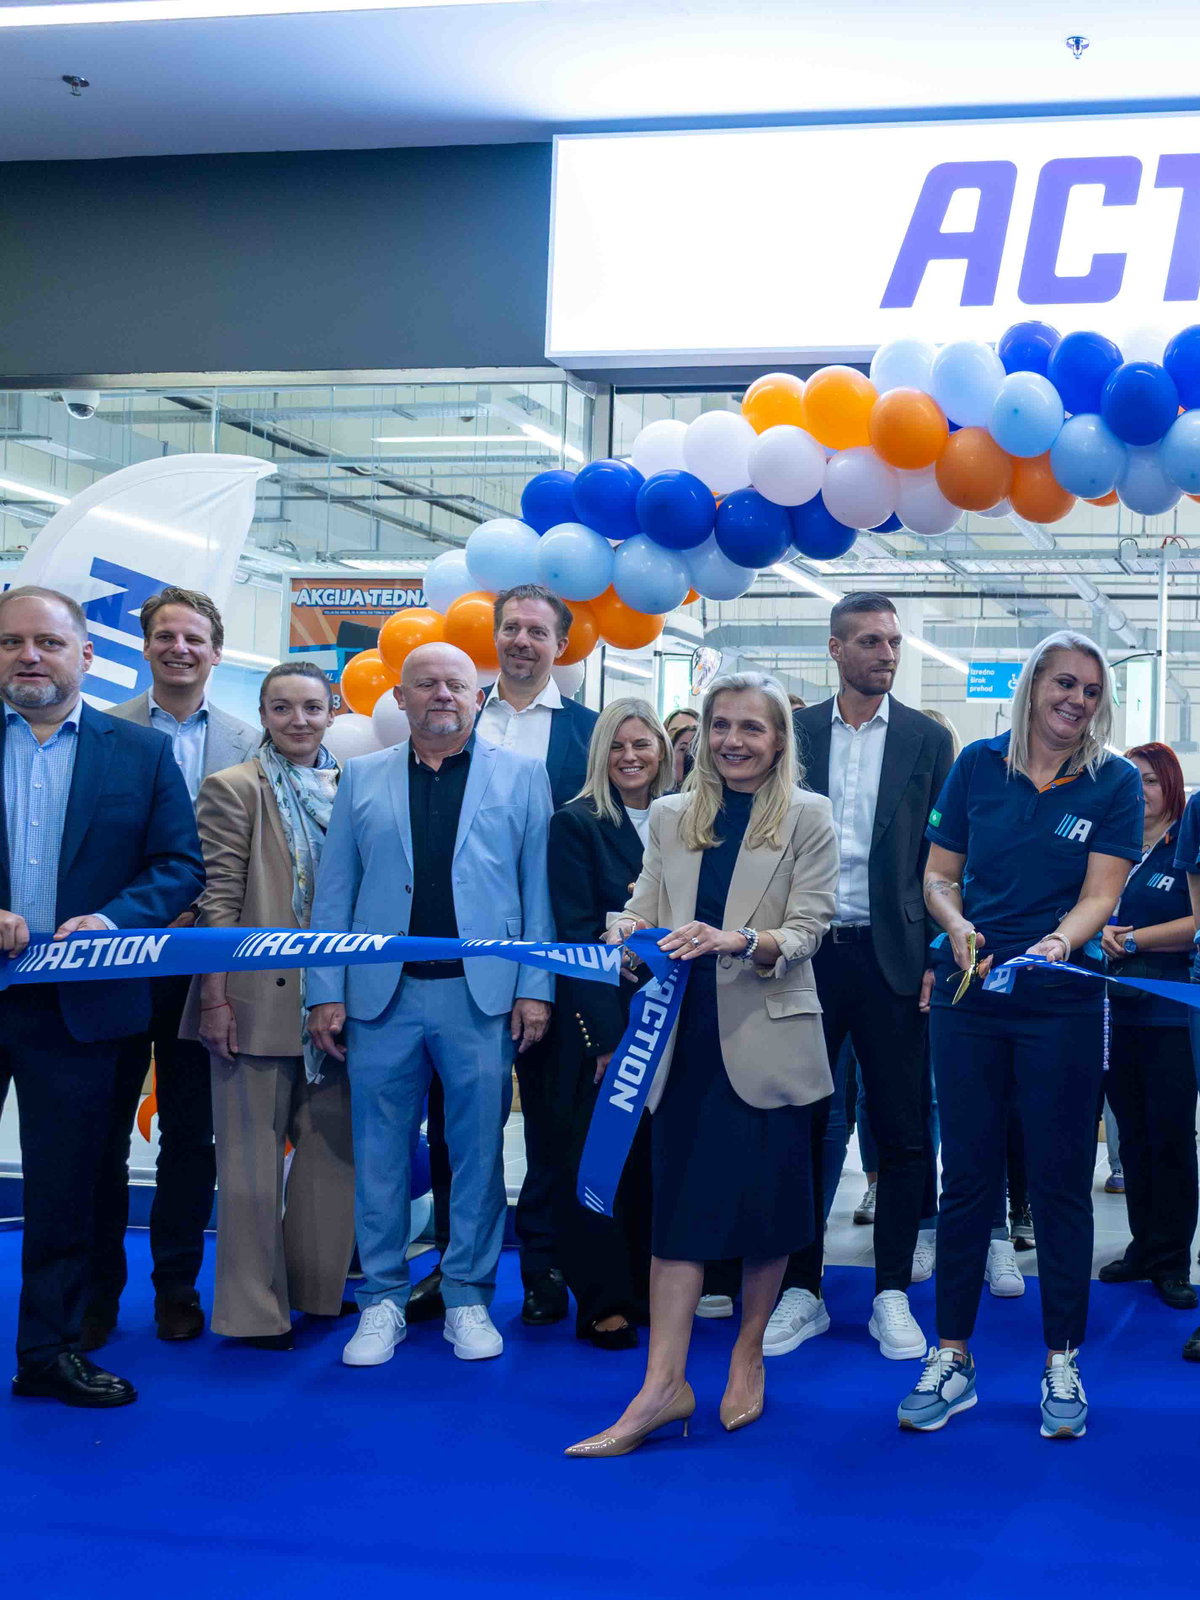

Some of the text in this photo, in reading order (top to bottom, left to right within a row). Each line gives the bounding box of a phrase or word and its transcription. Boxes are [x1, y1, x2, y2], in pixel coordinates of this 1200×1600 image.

[296, 588, 366, 607] AKCIJA
[970, 668, 995, 676] Izredno
[969, 685, 994, 693] prehod
[33, 934, 172, 972] ACTION
[252, 932, 398, 957] ACTION
